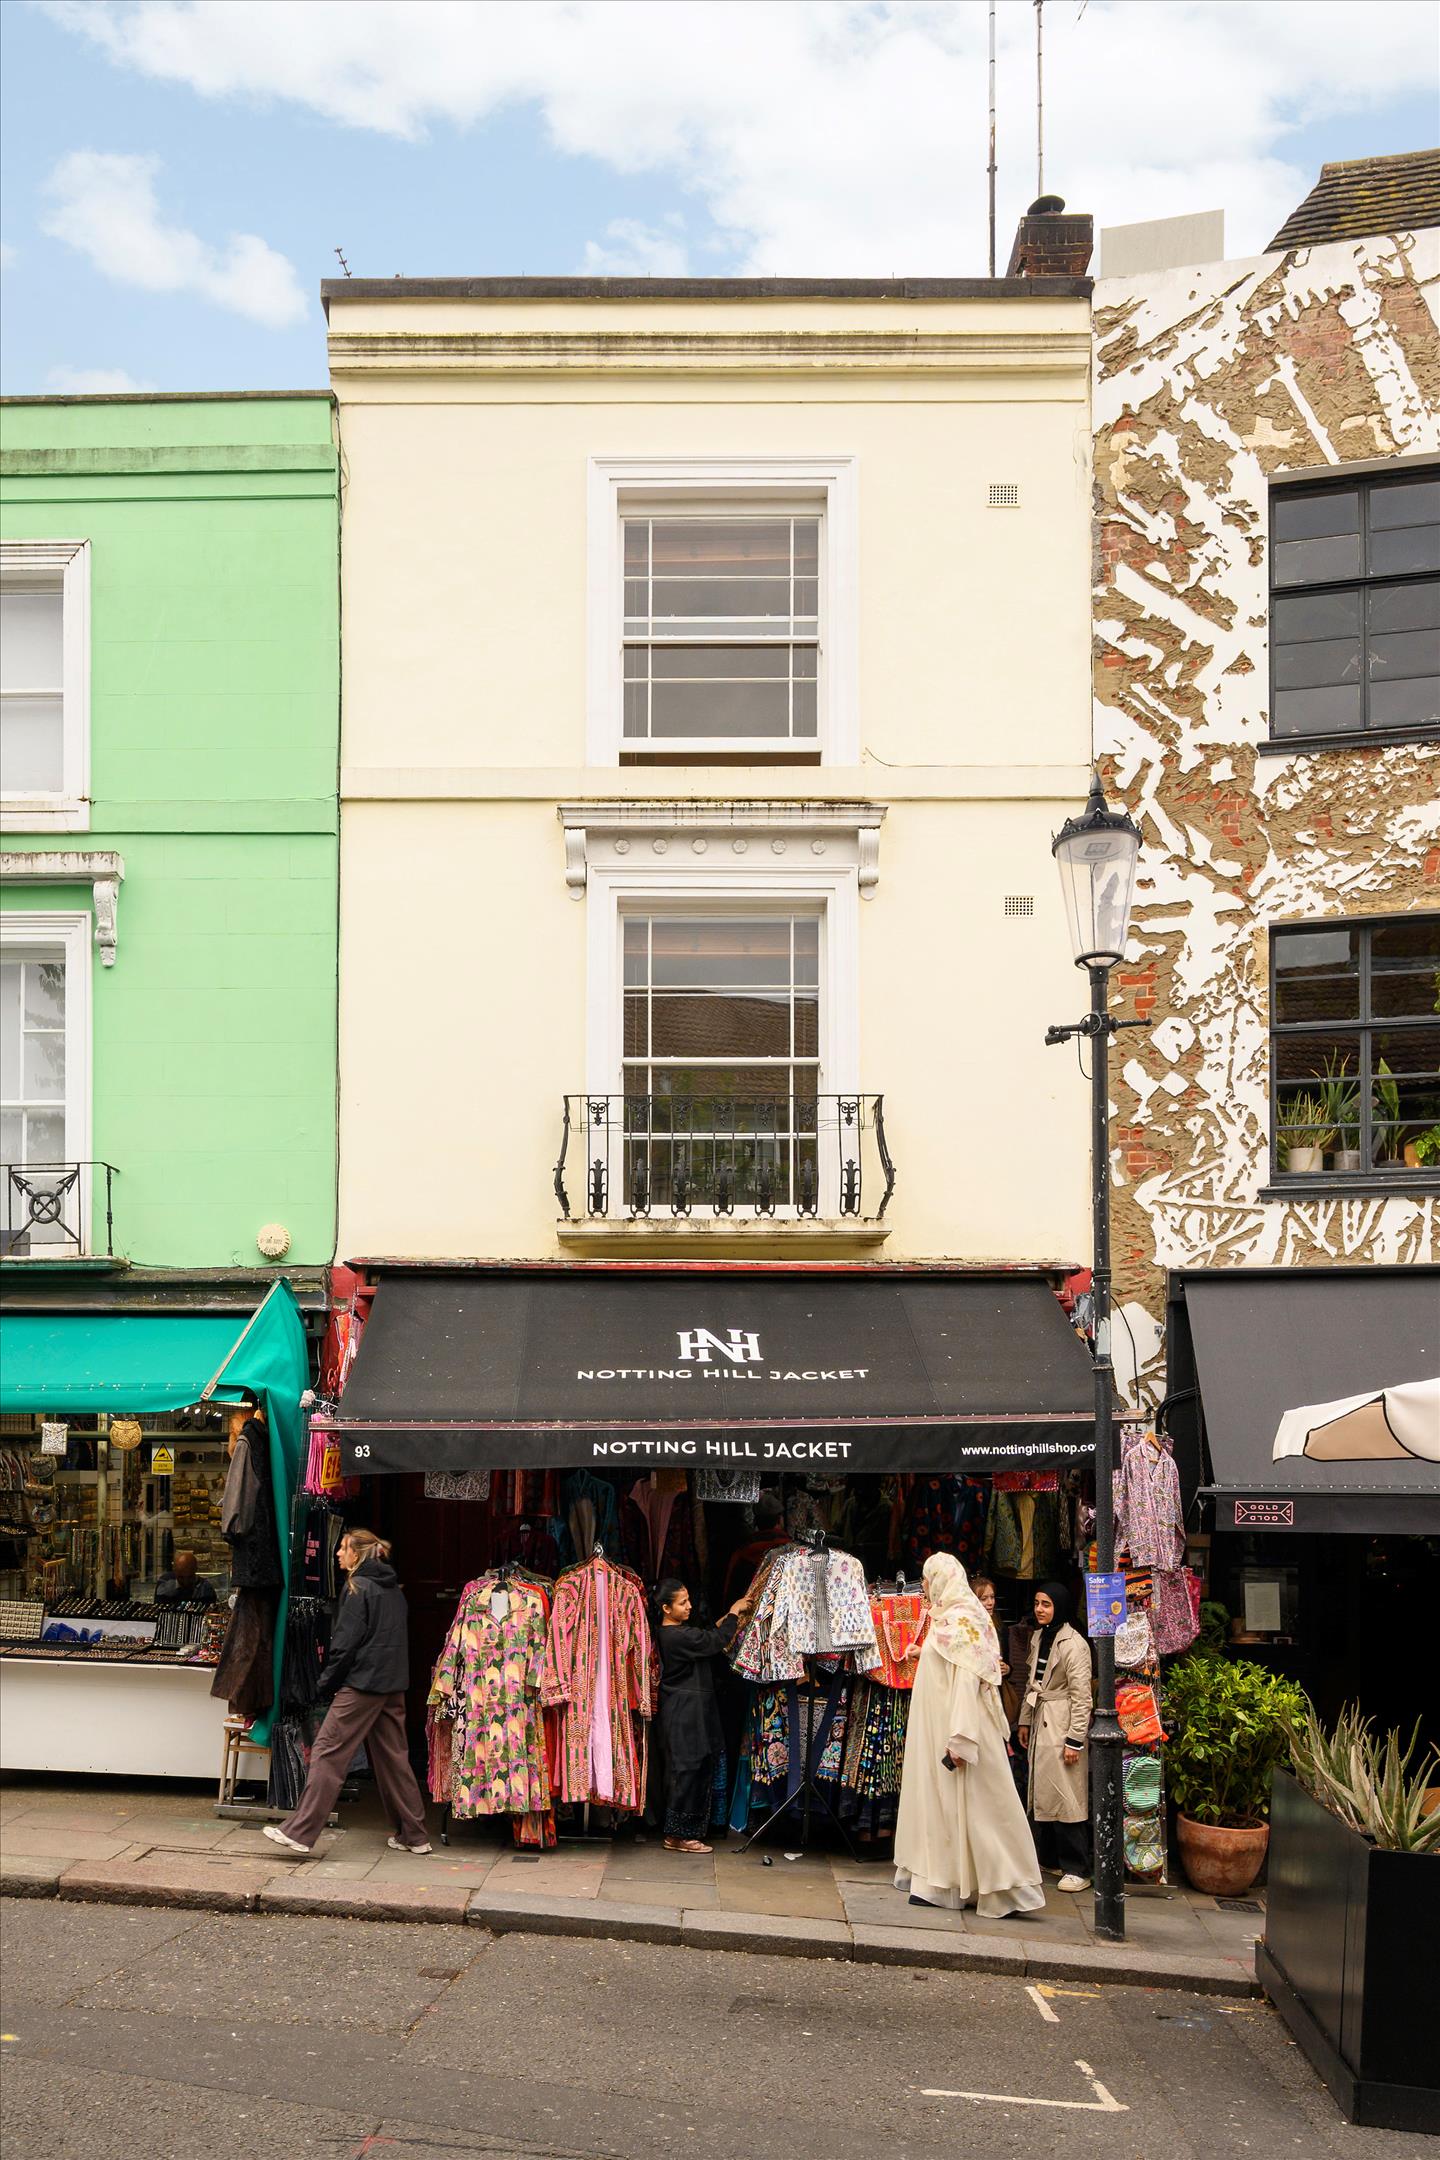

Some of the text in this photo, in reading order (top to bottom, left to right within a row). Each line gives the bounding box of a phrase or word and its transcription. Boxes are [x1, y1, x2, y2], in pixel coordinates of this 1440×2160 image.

[577, 1369, 869, 1381] NOTTING HILL JACKET
[354, 1445, 371, 1458] 93
[592, 1440, 852, 1459] NOTTING HILL JACKET
[961, 1442, 1097, 1456] www.nottinghillshop.co
[1088, 1576, 1105, 1584] Safer
